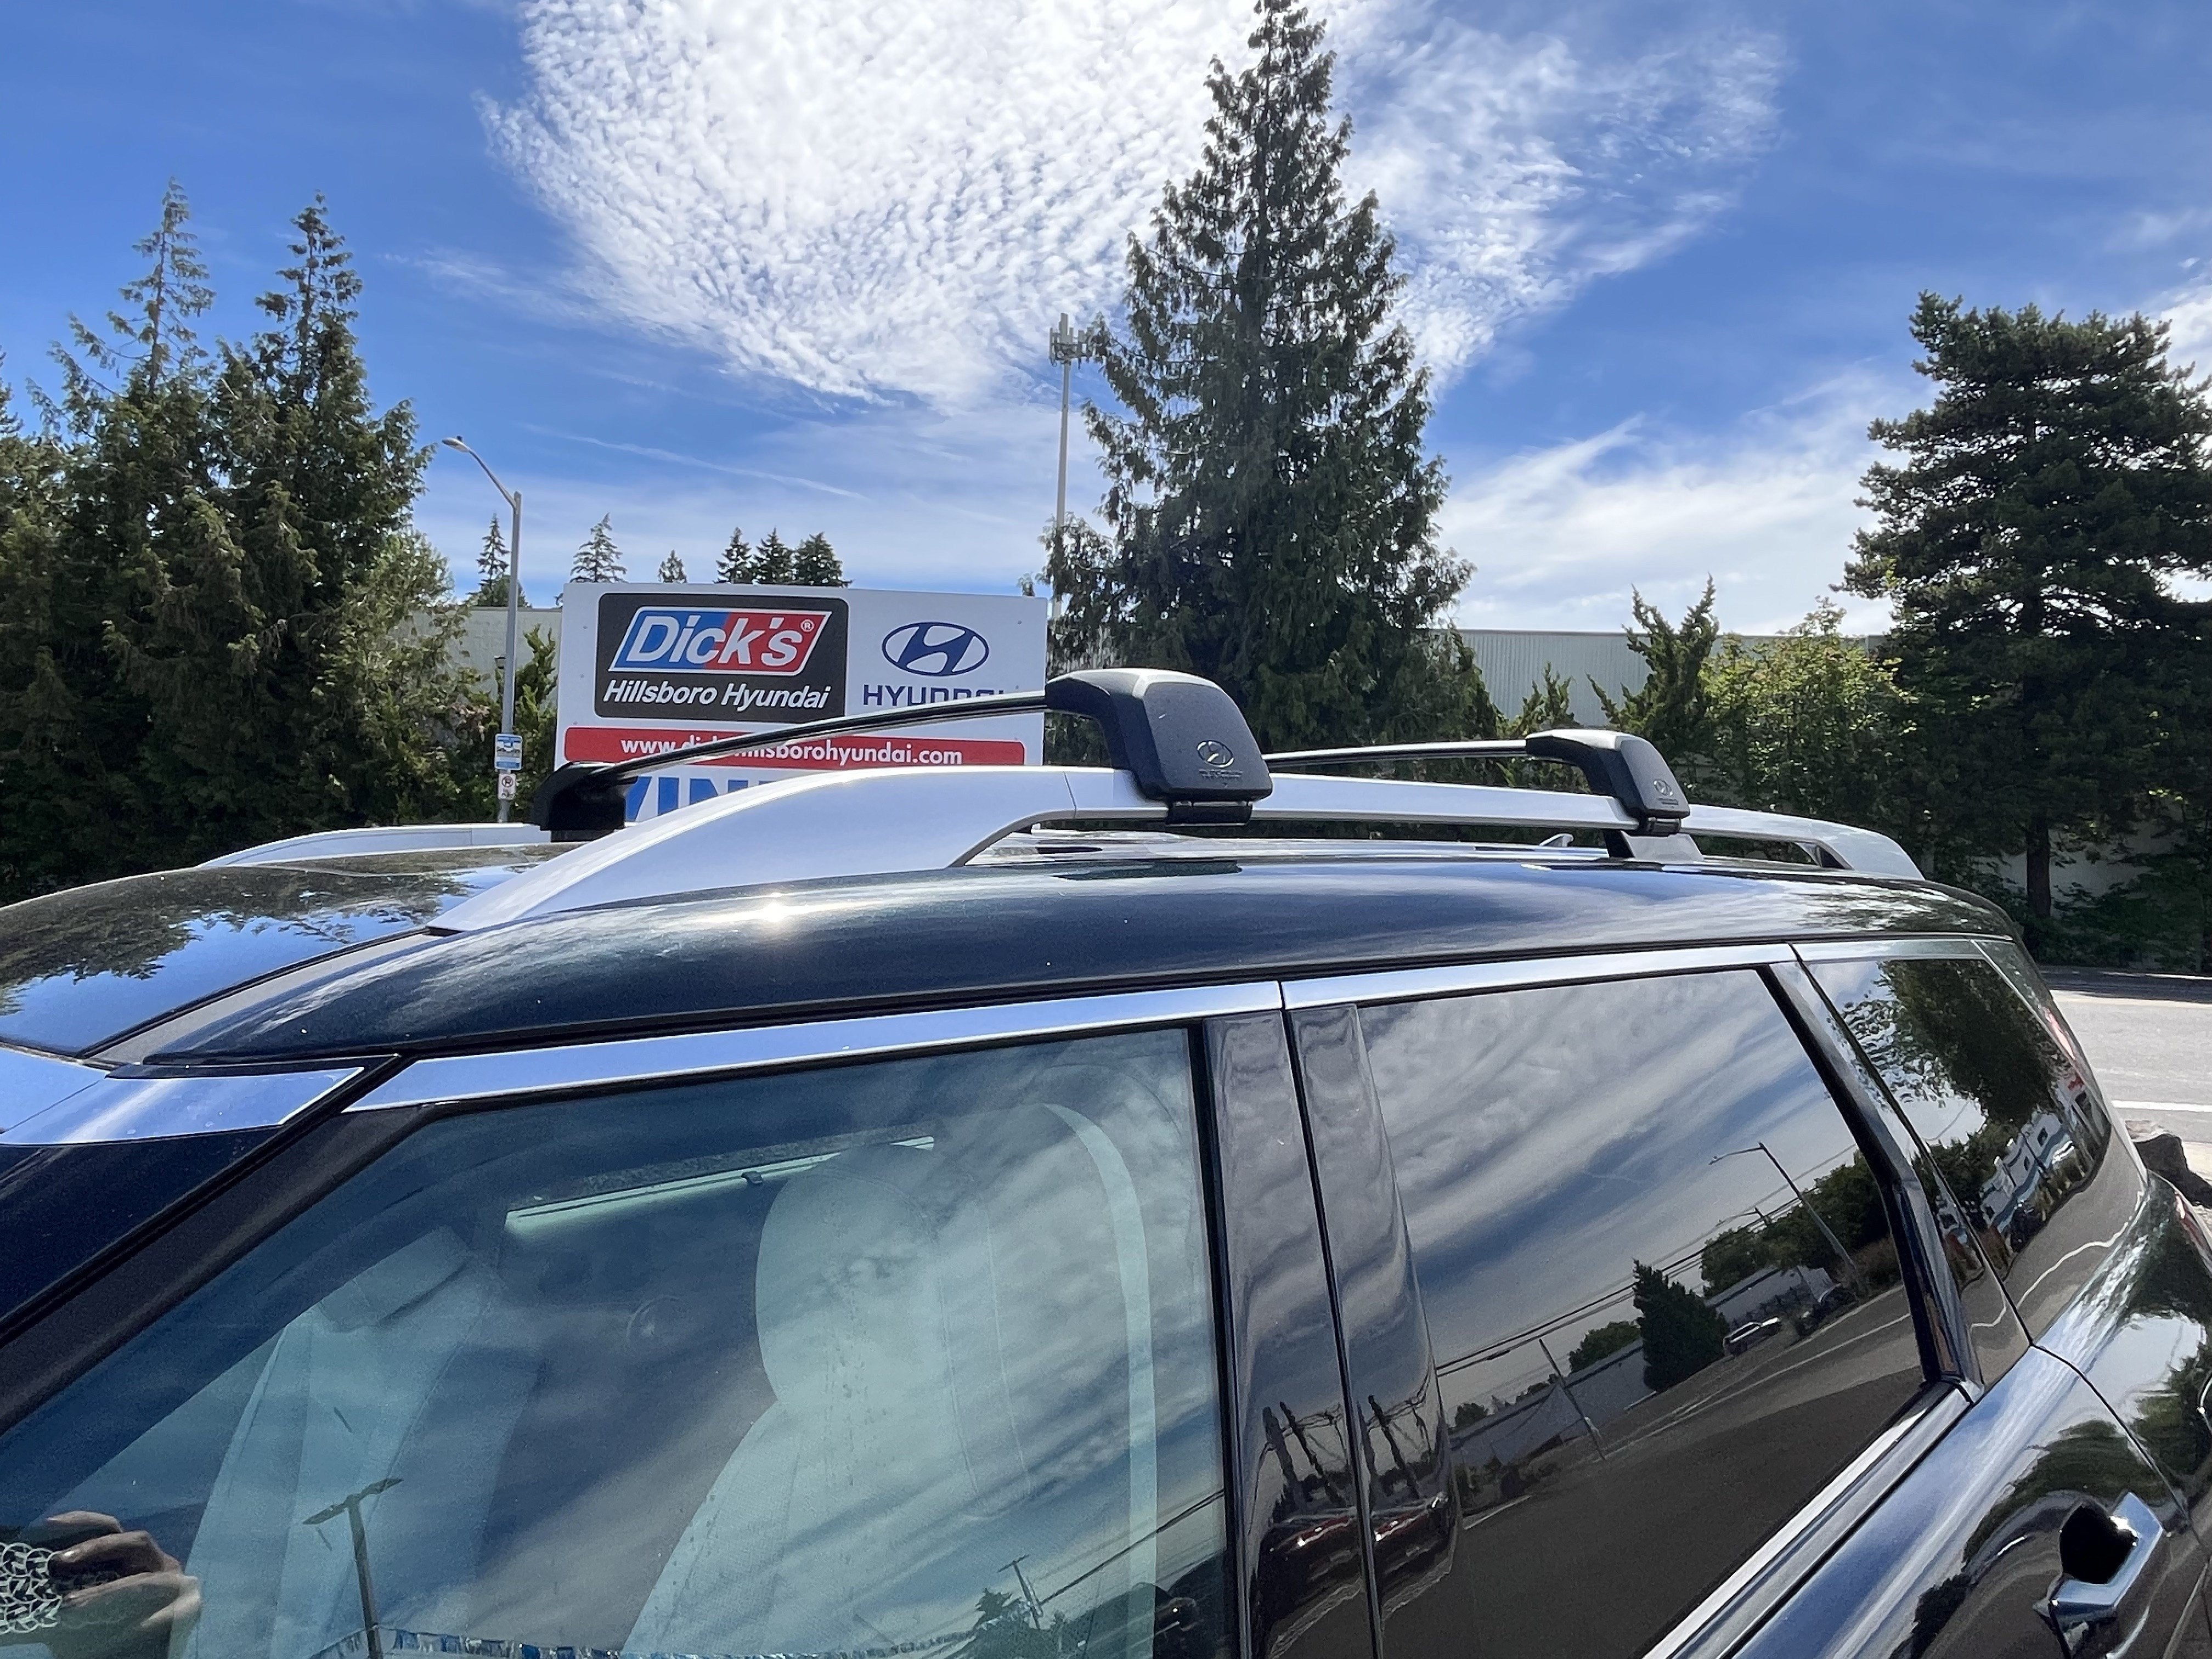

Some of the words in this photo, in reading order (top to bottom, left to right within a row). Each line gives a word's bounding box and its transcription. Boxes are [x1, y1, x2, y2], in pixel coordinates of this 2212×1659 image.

[603, 679, 718, 705] Hillsboro
[721, 683, 832, 712] Hyundai
[863, 684, 1004, 707] HYUN
